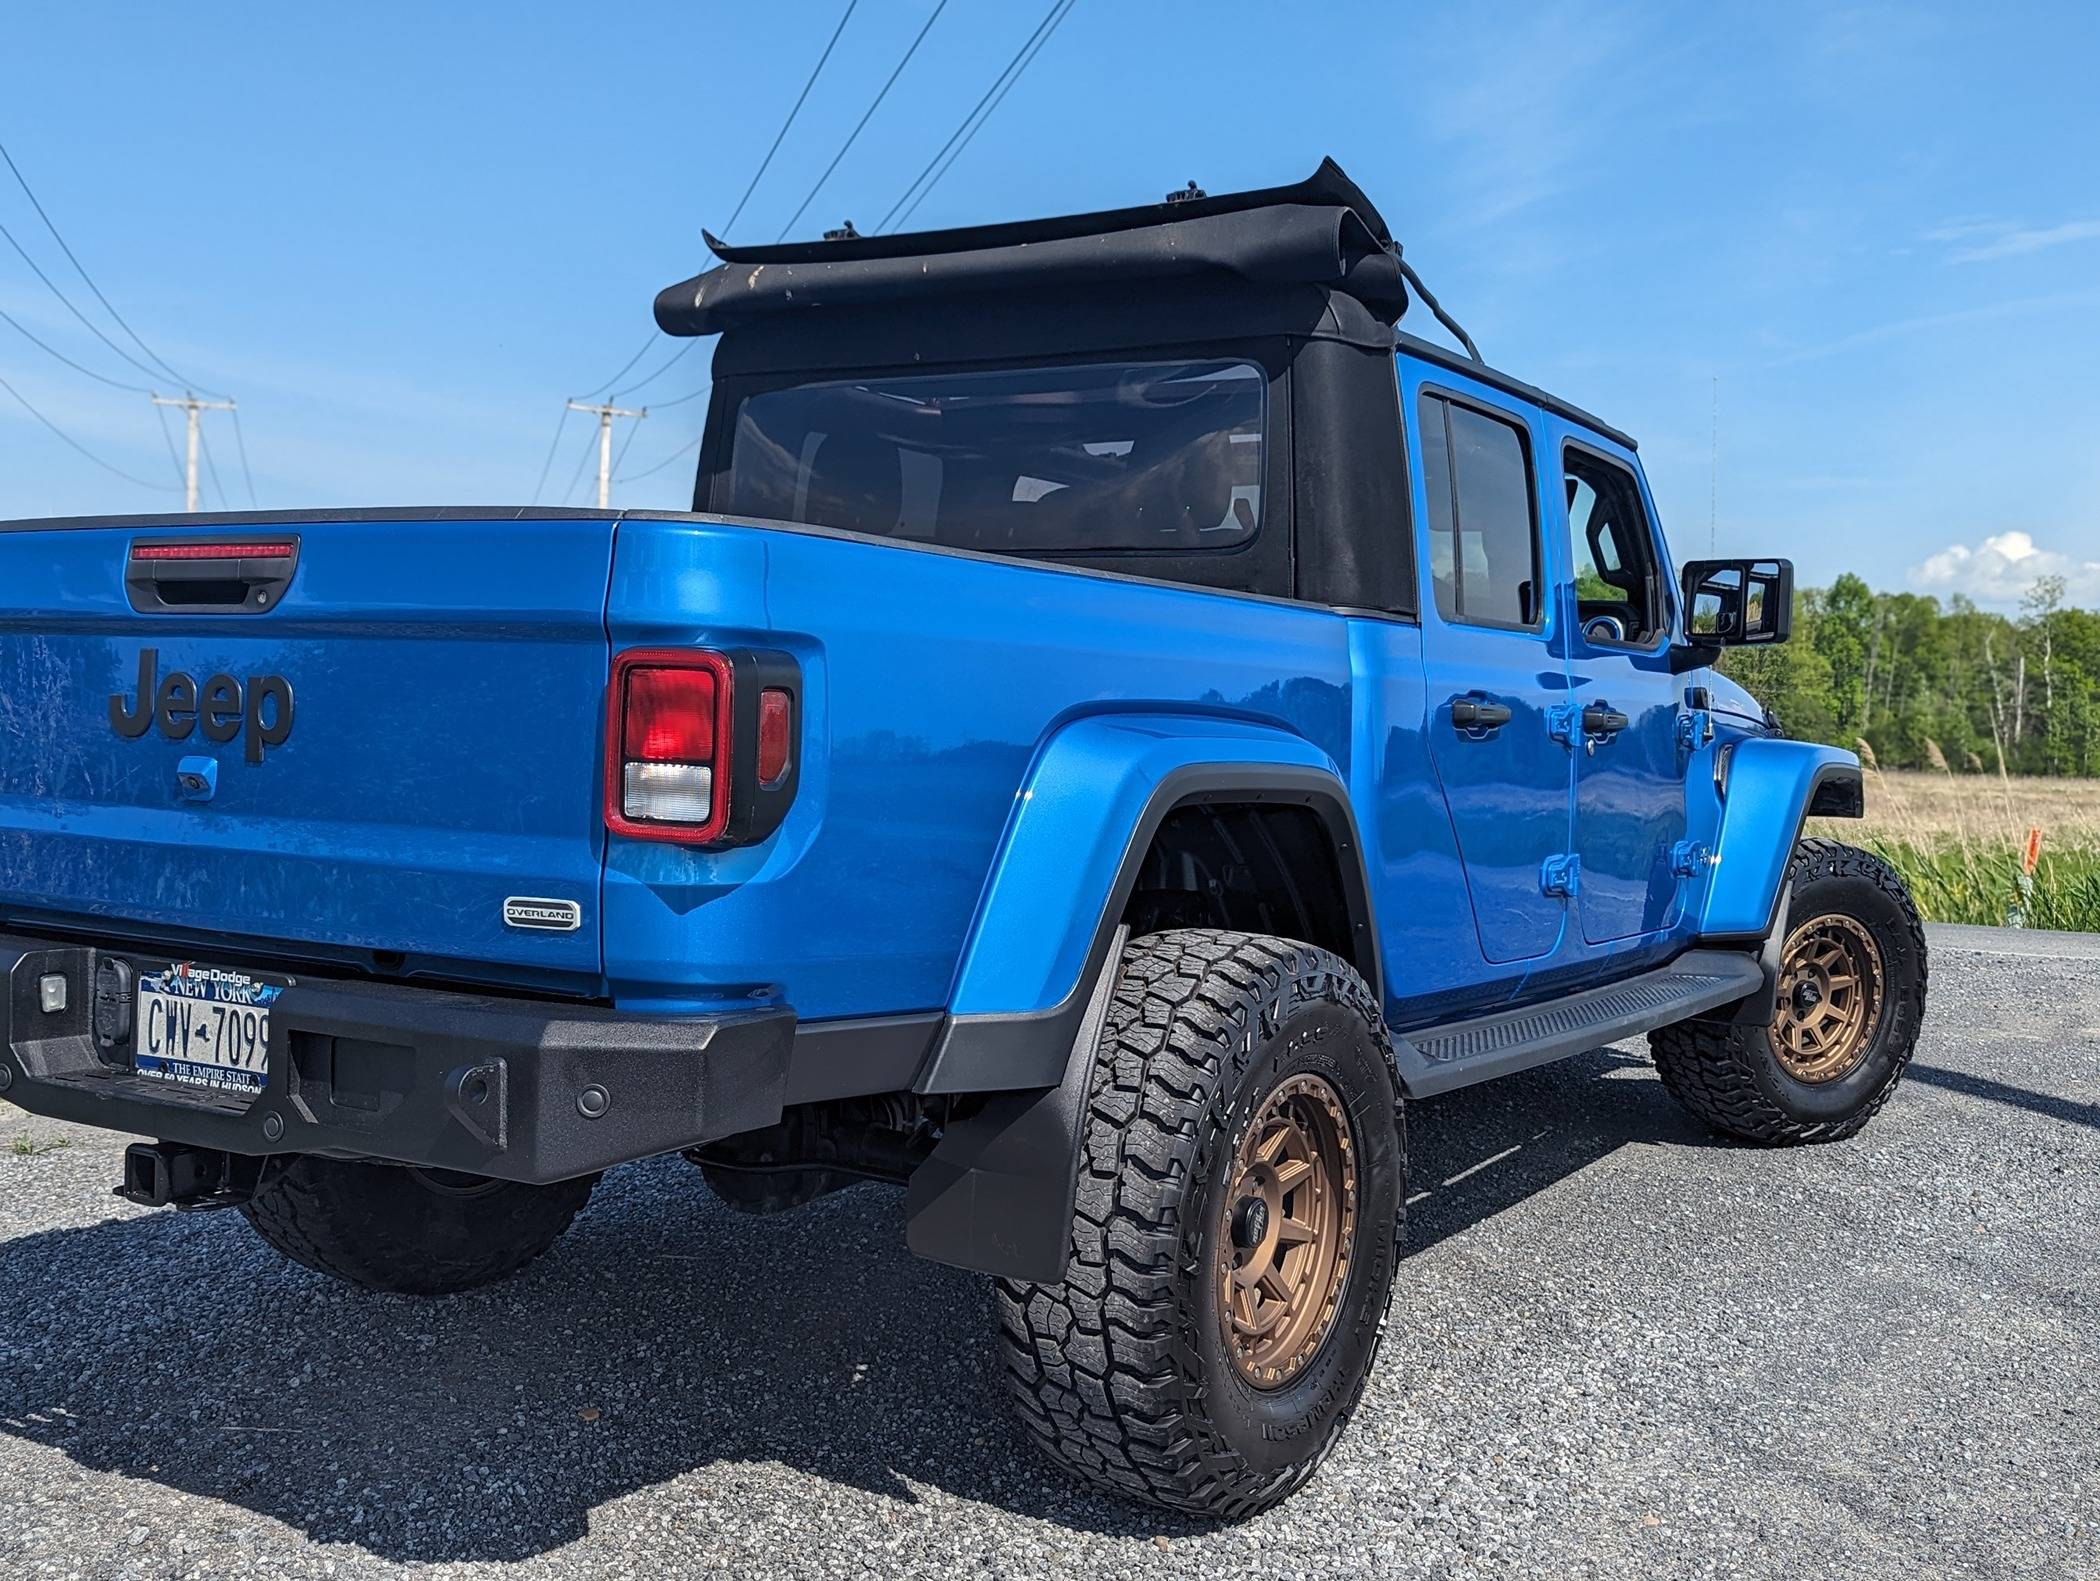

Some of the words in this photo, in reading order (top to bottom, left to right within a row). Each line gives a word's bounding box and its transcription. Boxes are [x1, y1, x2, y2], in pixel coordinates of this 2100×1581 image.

[109, 648, 294, 762] Jeep
[506, 908, 574, 920] OVERLAND
[175, 977, 207, 998] NEW
[213, 981, 252, 1005] YORK
[148, 998, 191, 1058] CWV
[172, 1062, 191, 1075] THE
[192, 1065, 225, 1081] EMPIRE
[209, 1080, 220, 1088] IN
[221, 1082, 262, 1095] HUDSON
